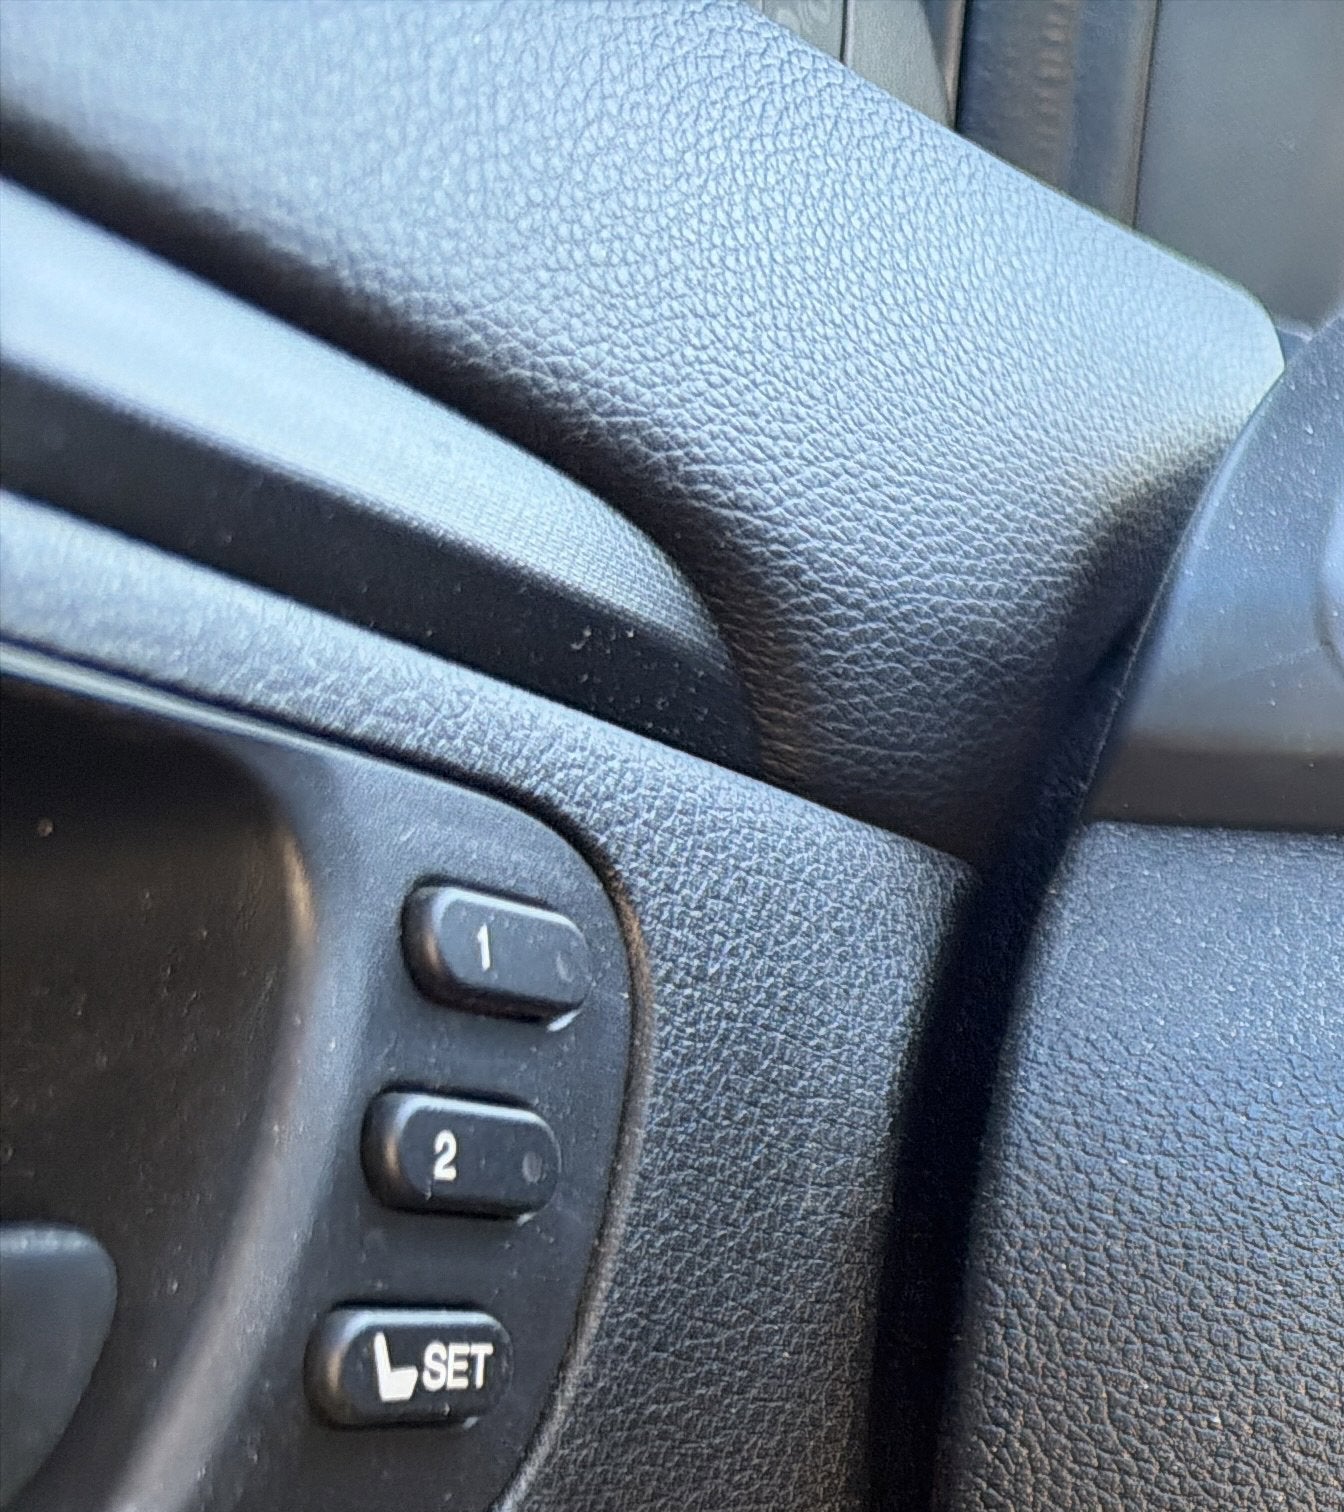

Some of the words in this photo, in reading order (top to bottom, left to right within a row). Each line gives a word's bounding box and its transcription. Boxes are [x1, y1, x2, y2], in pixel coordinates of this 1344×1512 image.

[476, 922, 491, 970] 1
[433, 1130, 457, 1181] 2
[422, 1342, 494, 1390] SET
